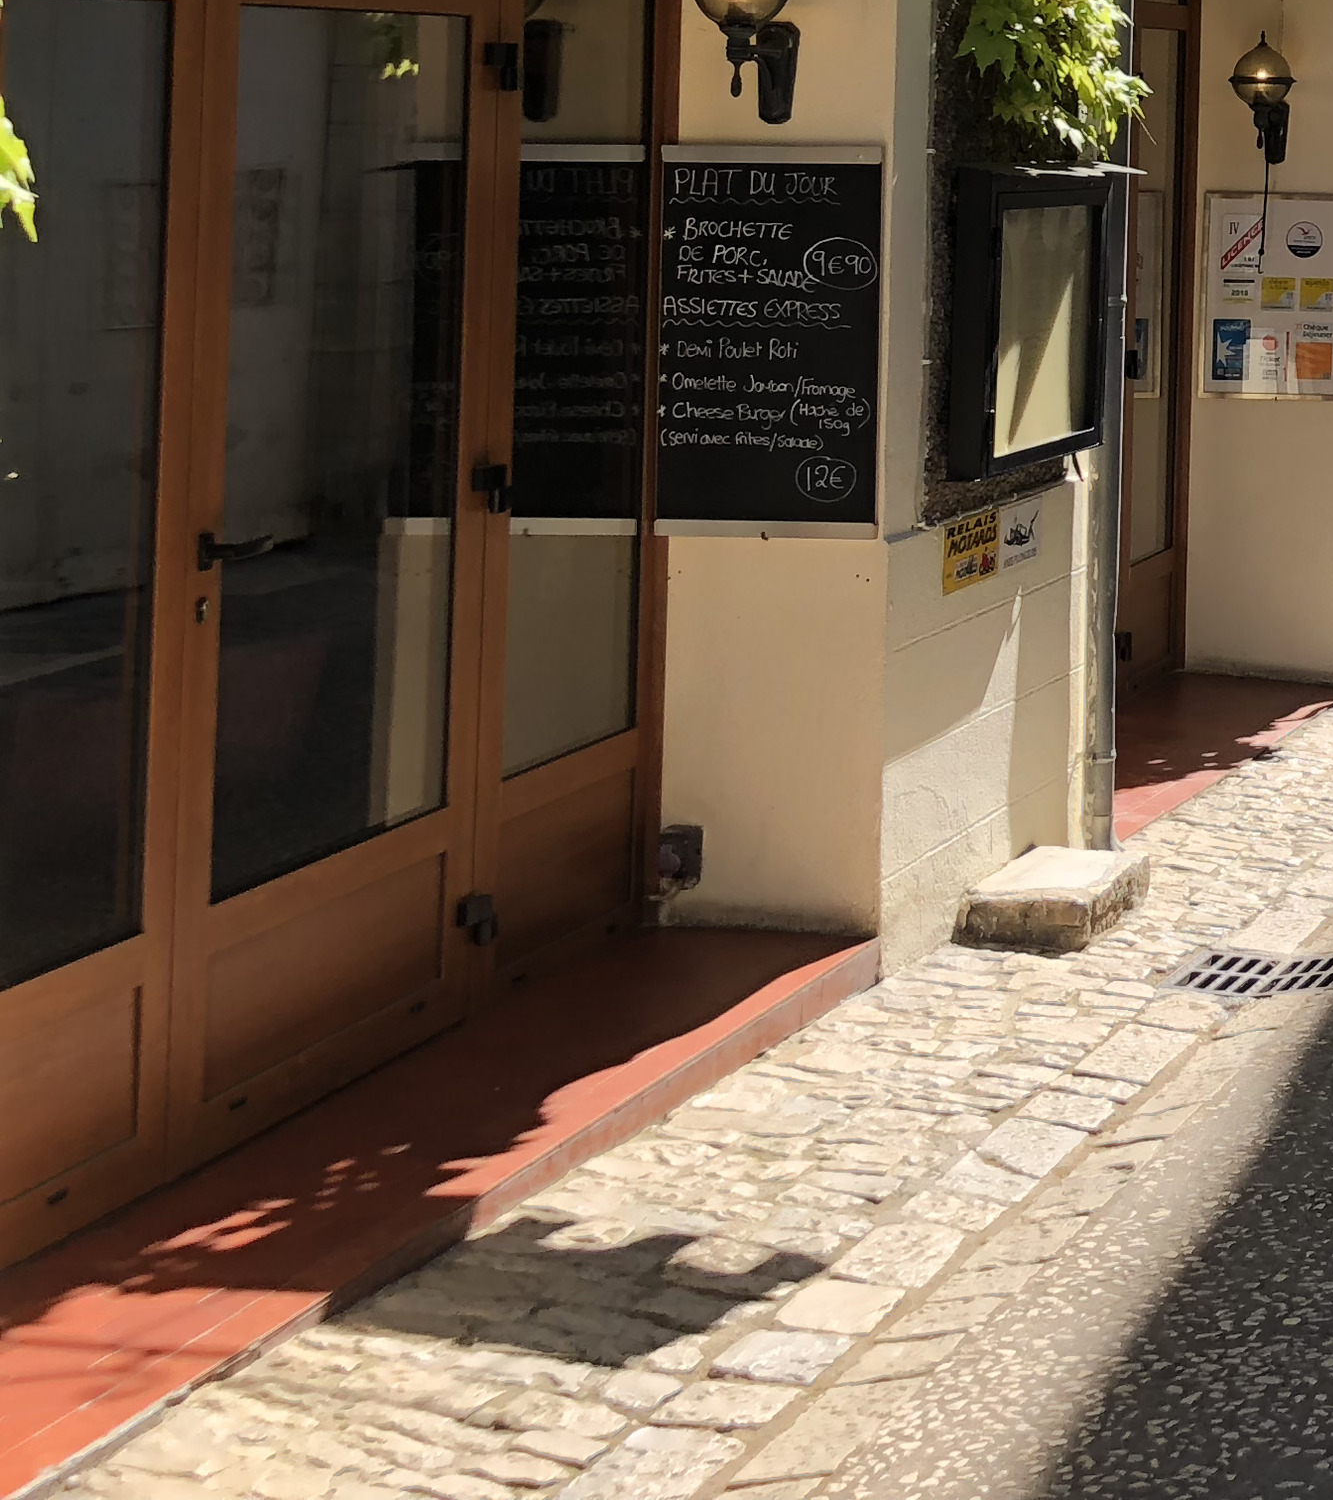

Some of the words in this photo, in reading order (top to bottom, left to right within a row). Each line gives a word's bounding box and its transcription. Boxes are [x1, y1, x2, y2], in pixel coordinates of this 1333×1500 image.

[674, 168, 743, 196] PLAT
[750, 170, 775, 195] DU
[784, 172, 838, 196] JOUR
[683, 217, 793, 240] BROCHETTE
[679, 245, 704, 261] DE
[811, 250, 872, 276] 9€90
[663, 296, 758, 318] ASSIETTES
[764, 298, 842, 321] EXPRESS
[677, 339, 712, 358] Demi
[719, 337, 763, 359] Poulet
[672, 372, 737, 392] Omelette
[672, 402, 734, 420] Cheese
[735, 404, 787, 430] Burger
[700, 434, 731, 445] avec
[806, 465, 847, 491] 12€
[946, 512, 997, 540] RELAIS
